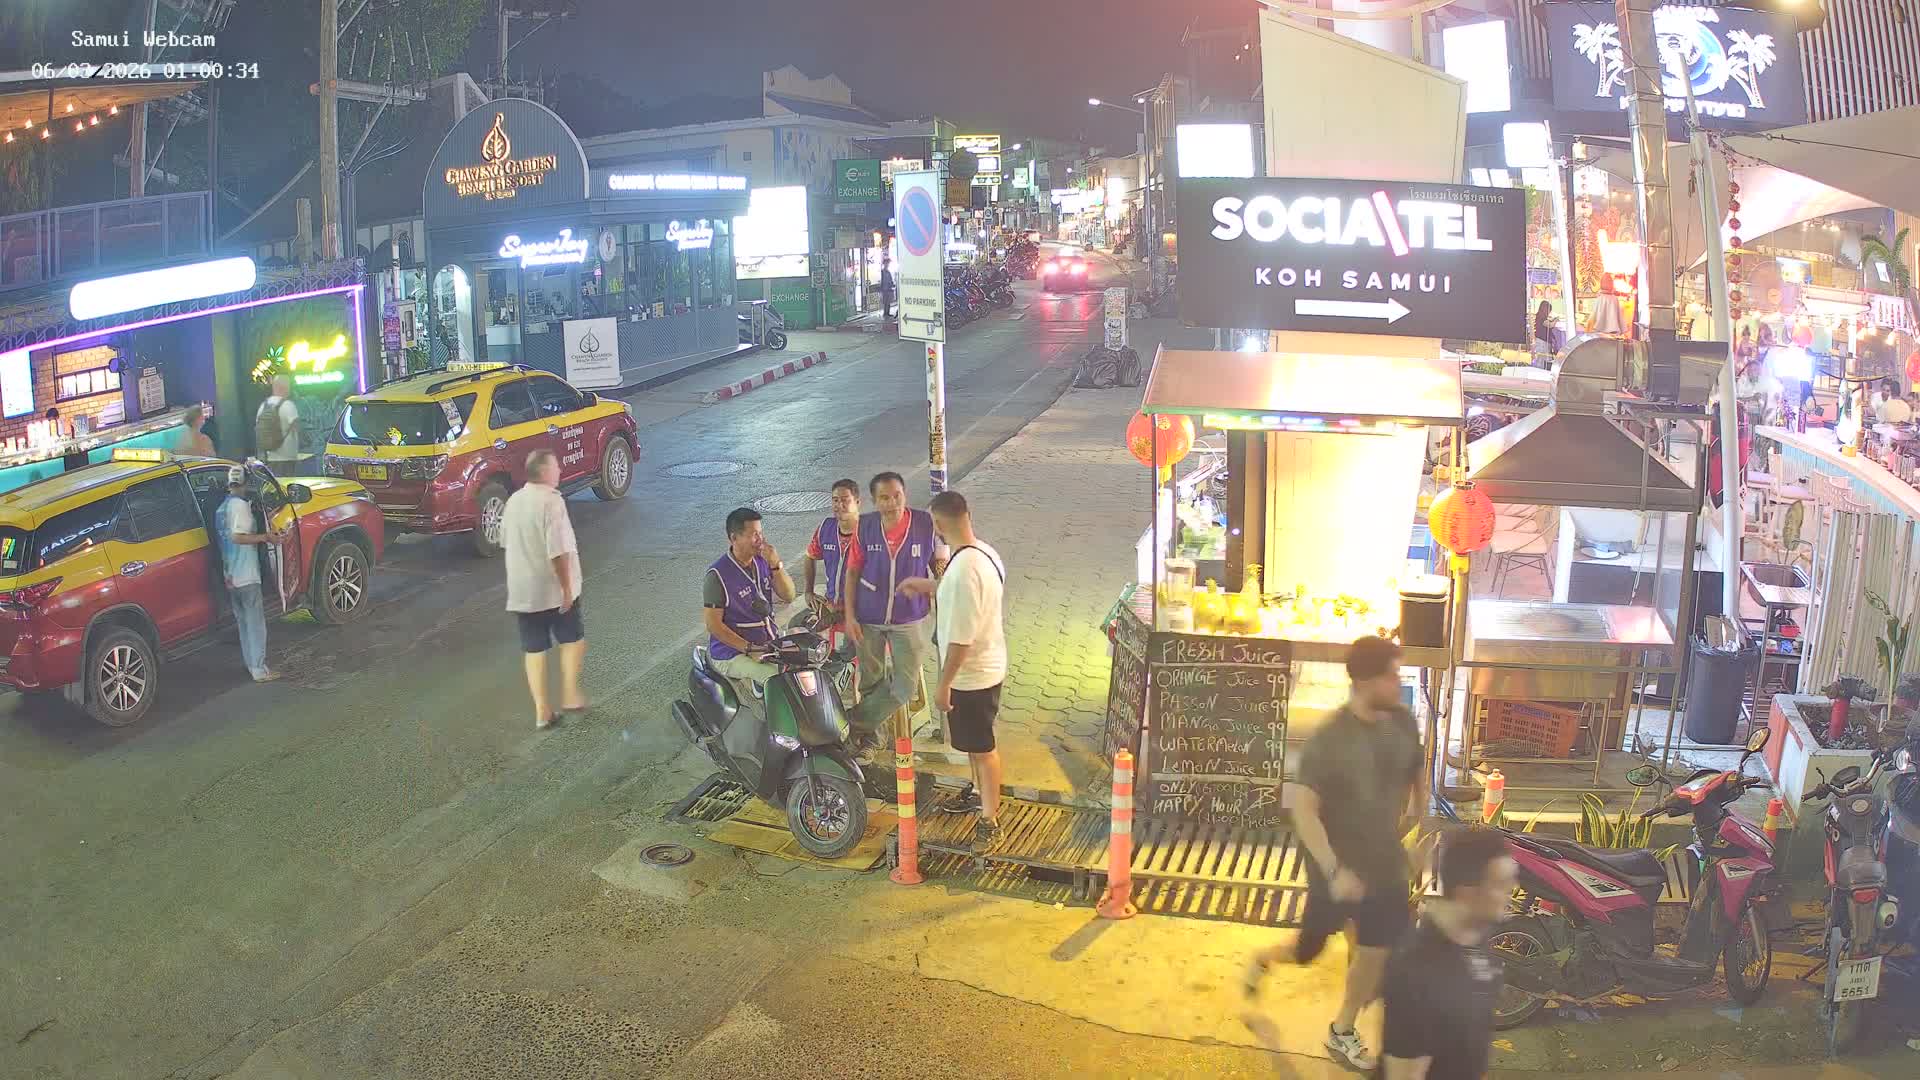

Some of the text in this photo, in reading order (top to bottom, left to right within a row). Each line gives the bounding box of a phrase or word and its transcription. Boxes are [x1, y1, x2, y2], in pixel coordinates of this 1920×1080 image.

[839, 187, 879, 198] EXCHANGE
[1255, 267, 1451, 293] KOH SAMUI
[771, 292, 810, 303] EXCHANGE
[904, 296, 937, 307] NO PARKING
[1162, 639, 1281, 665] FRESH Juice
[1156, 668, 1217, 689] ORANGE
[1266, 673, 1288, 698] 99
[1270, 699, 1288, 721] 99
[1267, 721, 1286, 741] 99
[1264, 739, 1285, 760] 99
[1261, 760, 1282, 780] 99
[1152, 795, 1204, 817] HAPPY
